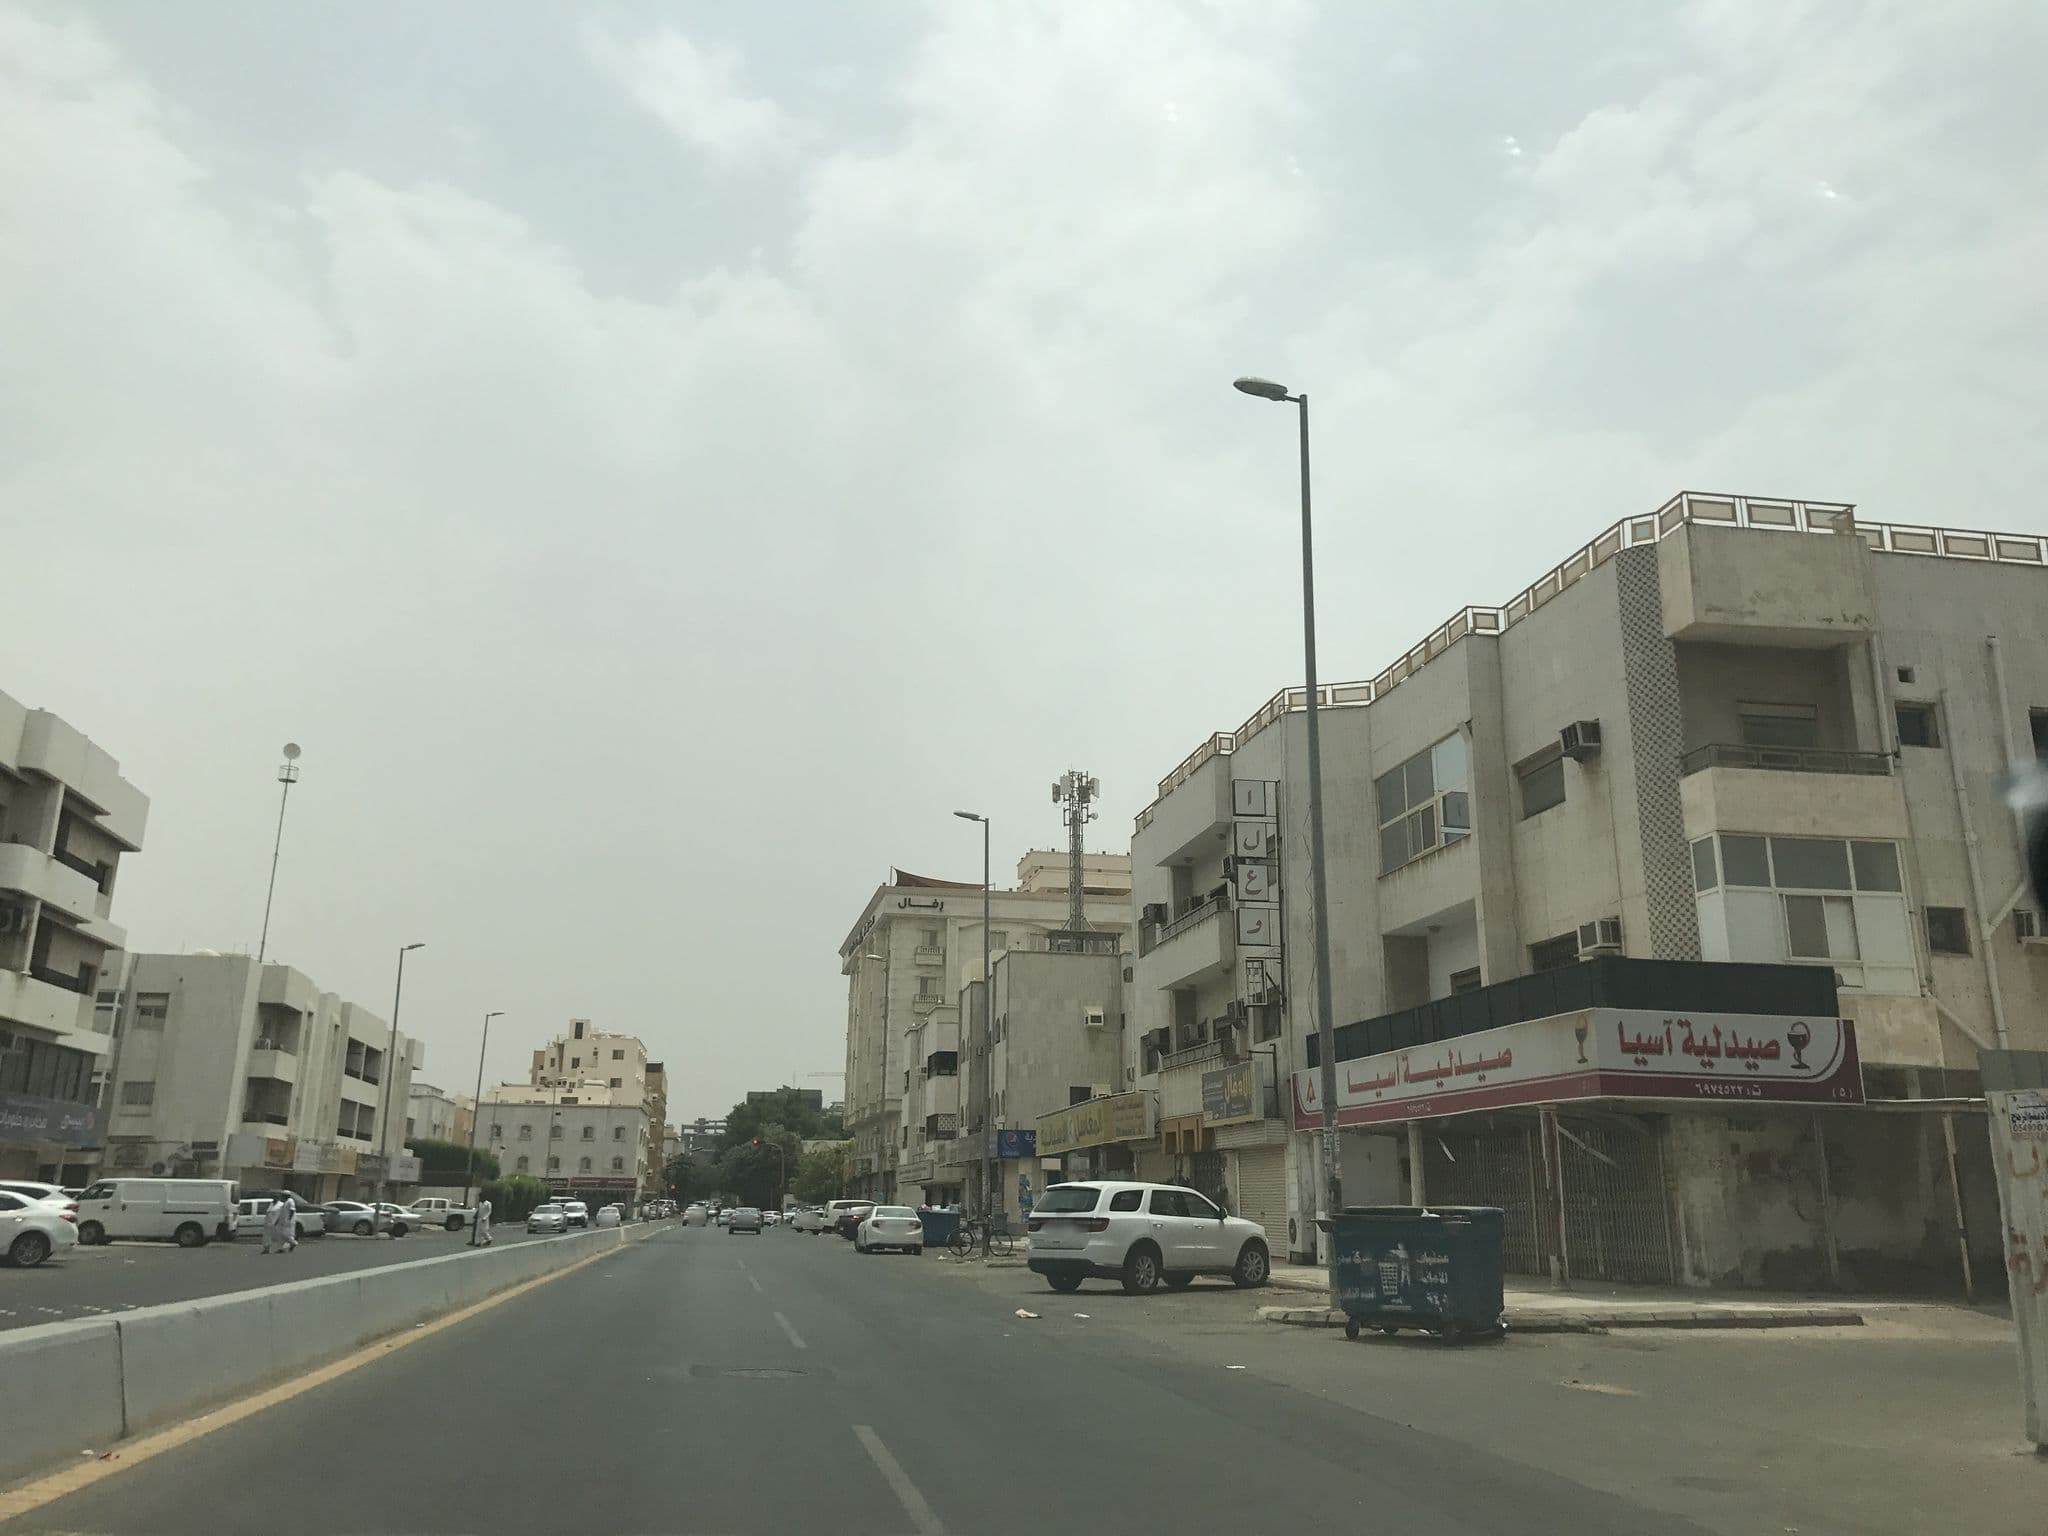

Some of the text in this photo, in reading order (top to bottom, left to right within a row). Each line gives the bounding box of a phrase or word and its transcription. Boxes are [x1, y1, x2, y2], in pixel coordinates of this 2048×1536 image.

[897, 897, 944, 912] رفال
[1618, 1018, 1781, 1071] صيدلية آسيا
[1404, 1047, 1512, 1089] صيدلية
